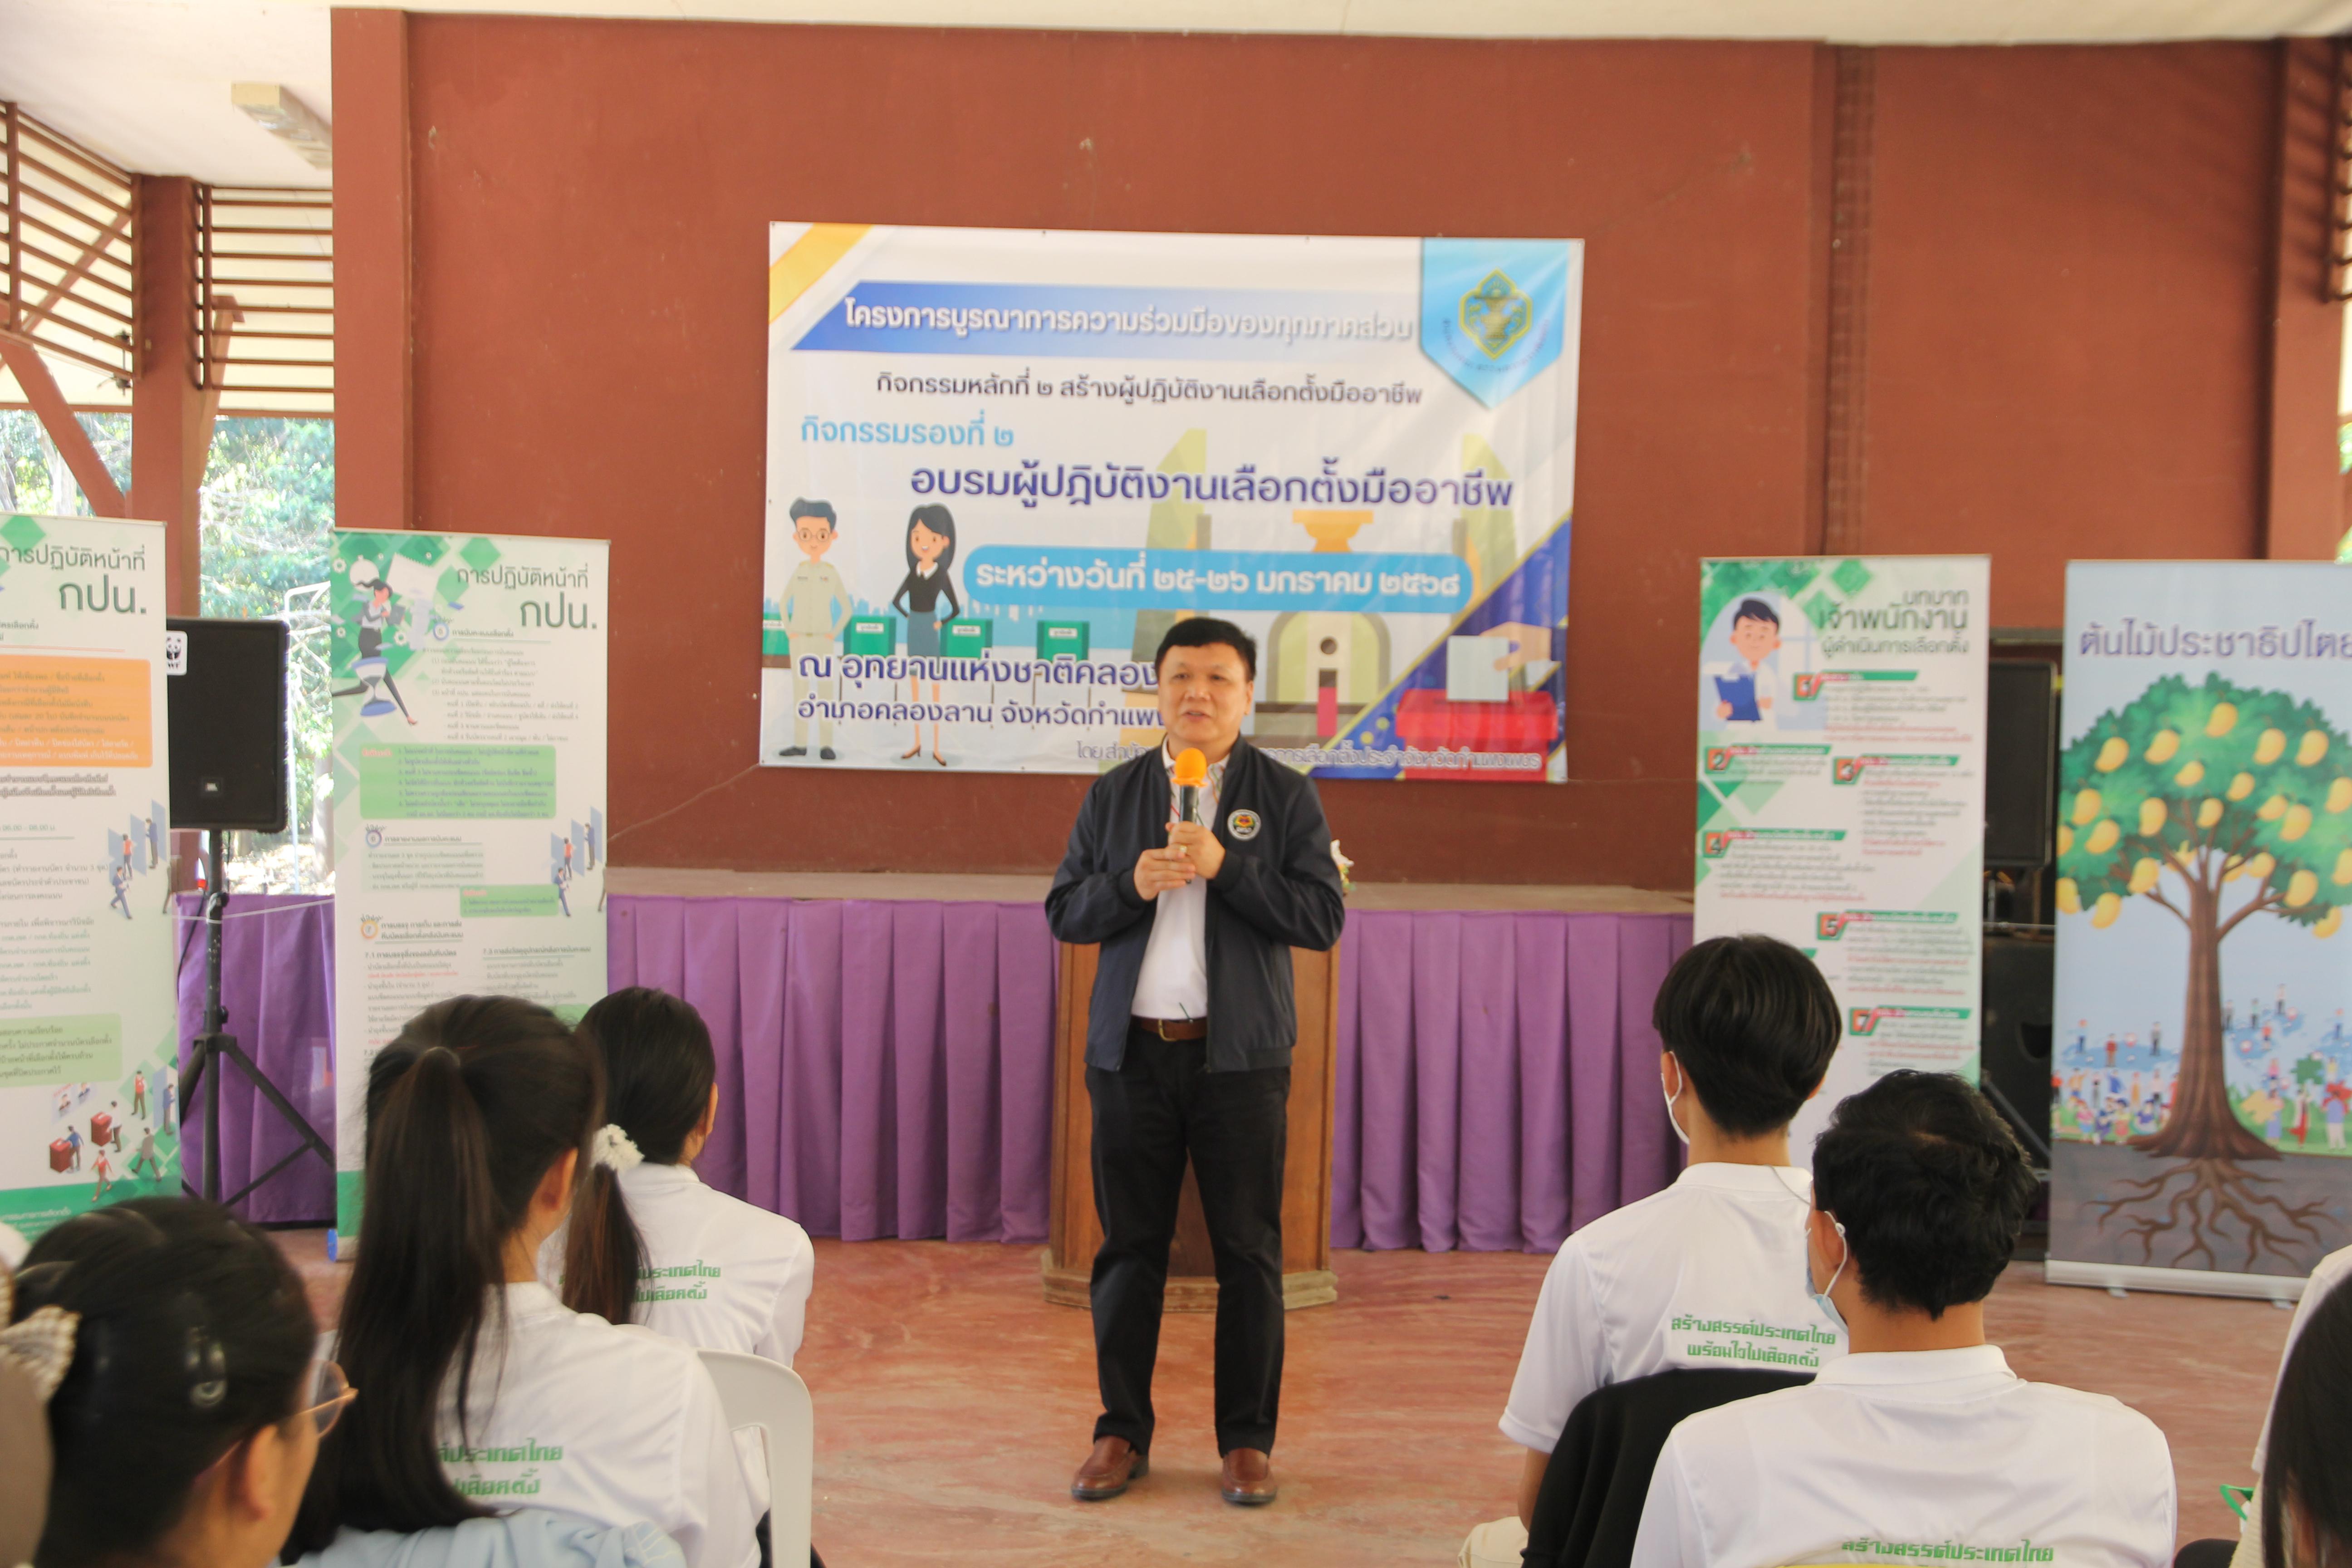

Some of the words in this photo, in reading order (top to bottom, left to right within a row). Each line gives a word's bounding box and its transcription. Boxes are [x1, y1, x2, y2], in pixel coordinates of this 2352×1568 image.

[844, 297, 1414, 345] โครงการบูรณาการความร่วมมือของทุกภาคส่วน
[877, 367, 1030, 395] กิจกรรมหลักที่
[1037, 381, 1053, 396] ๒
[1060, 373, 1423, 404] สร้างผู้ปฏิบัติงานเลือกตั้งมืออาชีพ
[801, 409, 985, 446] กิจกรรมรองที่
[994, 425, 1014, 446] ๒
[911, 456, 1514, 508] อบรมผู้ปฏิบัติงานเลือกตั้งมืออาชีพ
[457, 563, 589, 589] การปฏิบัติหน้าที่
[976, 551, 1147, 590] ระหว่างวันที่
[1257, 570, 1372, 595] มกราคม
[59, 573, 147, 614] กปน.
[520, 591, 597, 630] กปน.
[1818, 601, 1968, 629] เจ้าพนักงาน
[799, 654, 832, 679] ณ
[798, 694, 993, 725] อำเภอคลองลาน
[1671, 1314, 1836, 1345] สร้างสรรค์ประเทศไทย
[1687, 1340, 1819, 1367] พร้อมใจไปเลือกตั้ง
[1842, 1537, 2054, 1563] สร้างสรรค์ประเทศไทย
